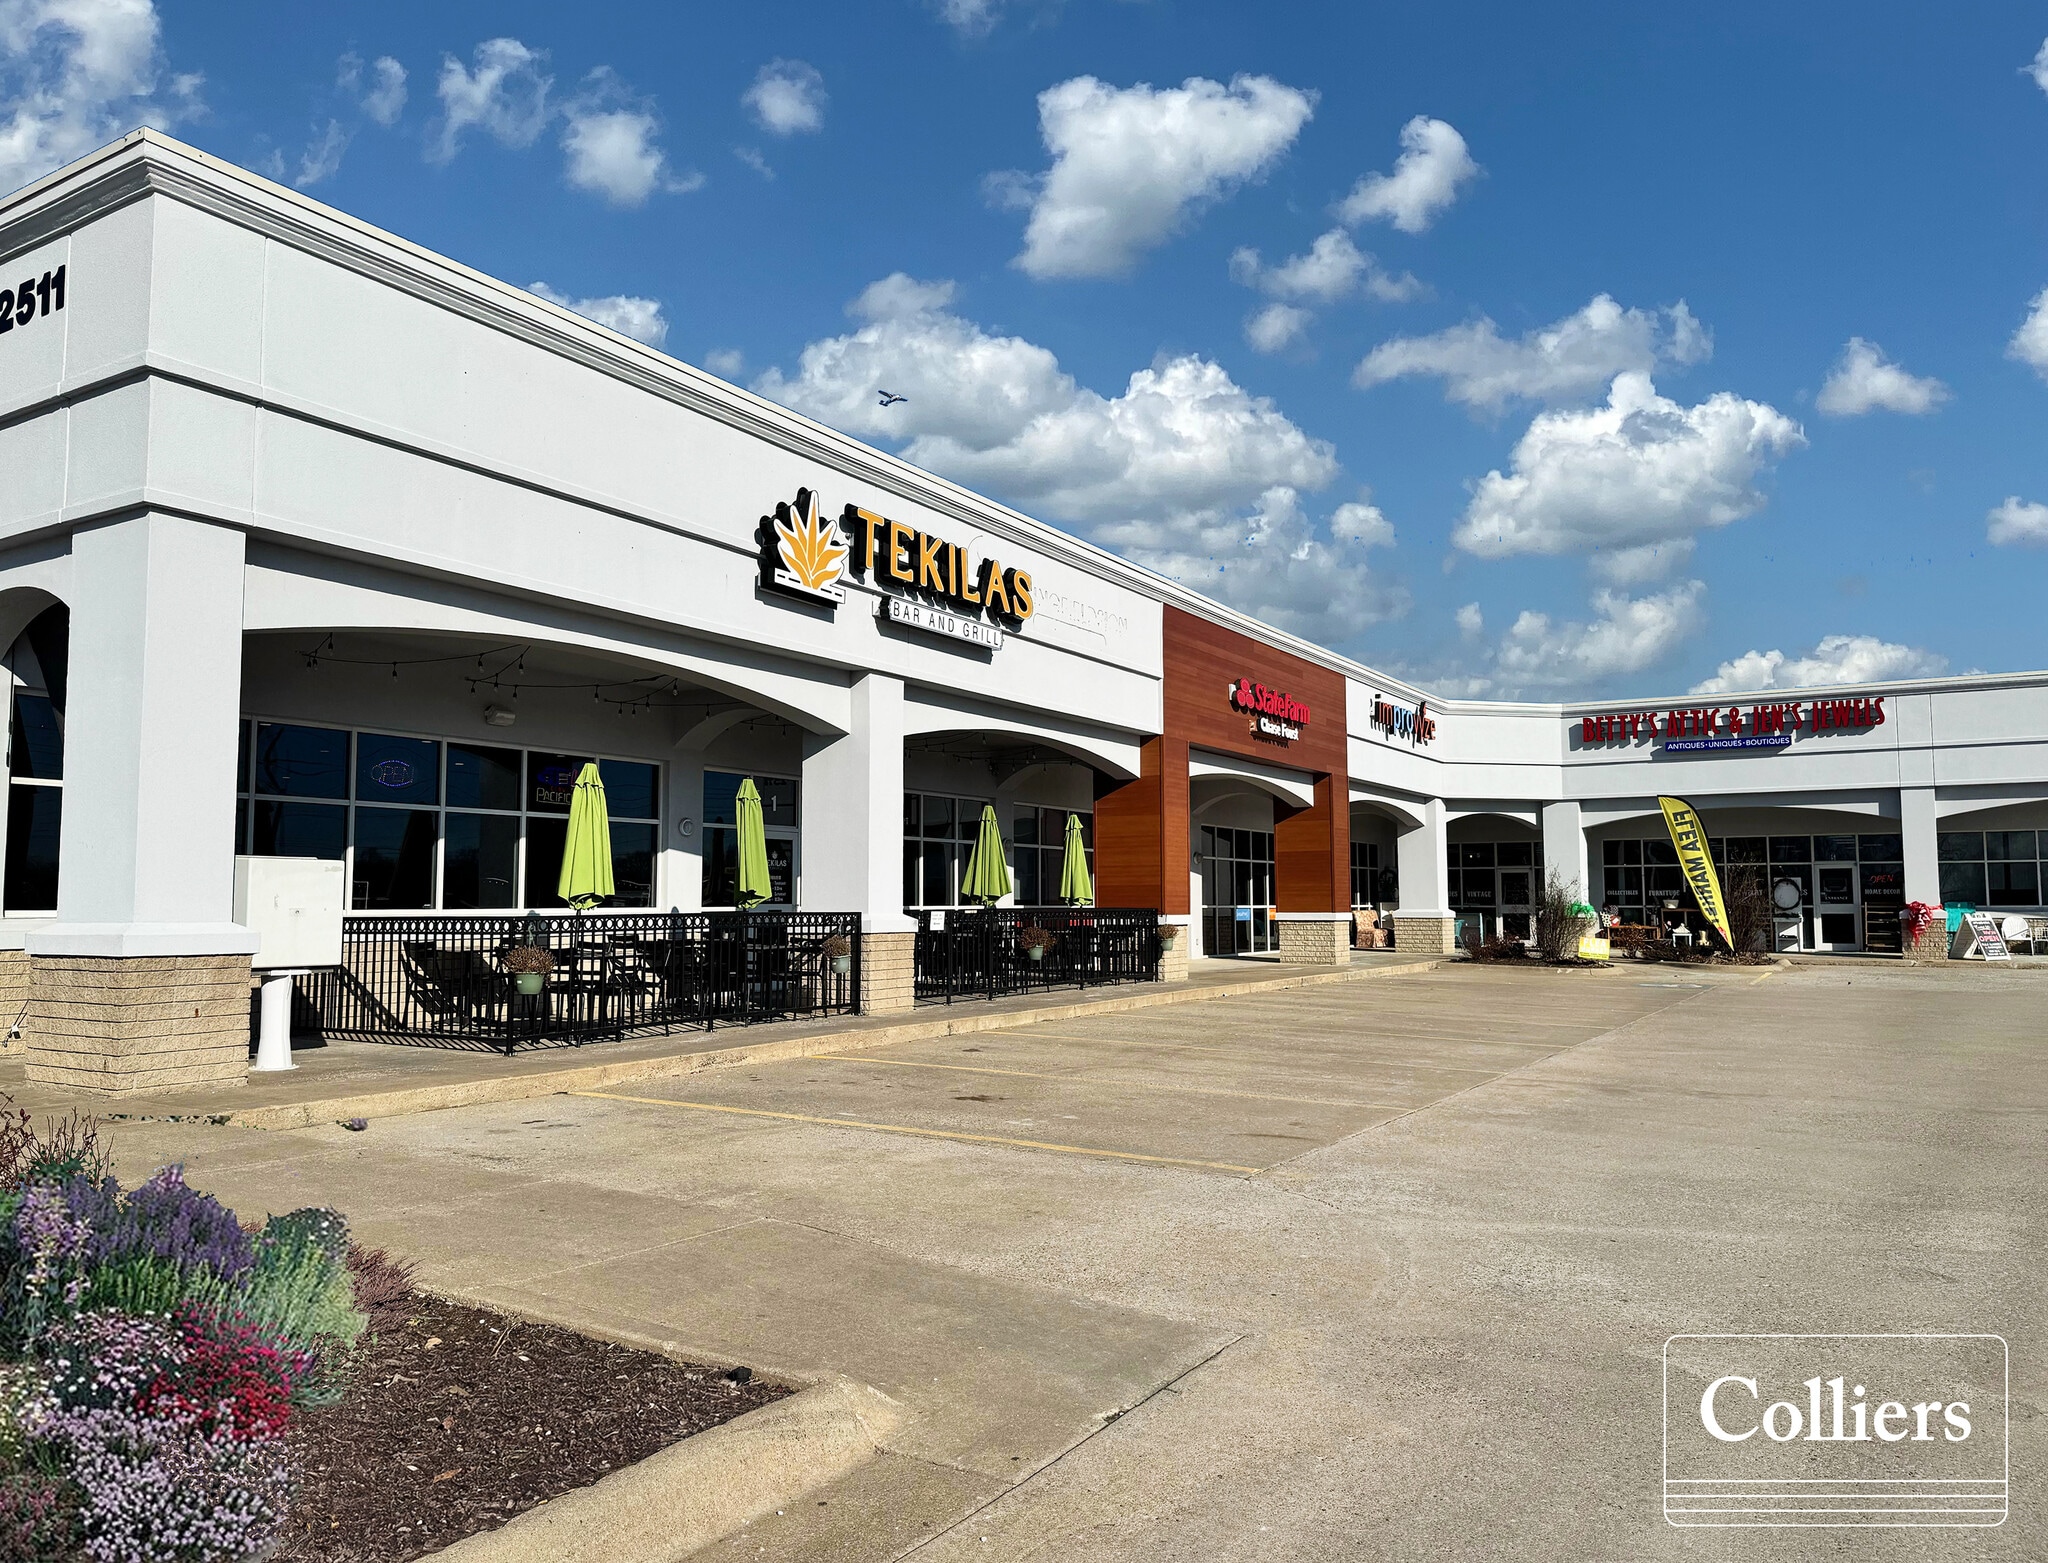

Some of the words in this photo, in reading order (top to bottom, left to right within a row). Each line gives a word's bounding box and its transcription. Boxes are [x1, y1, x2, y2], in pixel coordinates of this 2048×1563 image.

[0, 264, 66, 335] 2511
[857, 507, 1033, 620] TEKILAS
[893, 601, 920, 623] BAR
[928, 612, 955, 633] AND
[962, 622, 999, 646] GRILL
[1582, 712, 1658, 742] BETTY'S
[1667, 708, 1720, 738] ATTIC
[1729, 706, 1742, 734] &
[1752, 702, 1803, 736] JEN'S
[1811, 697, 1886, 732] JEWELS
[371, 764, 414, 783] OPEN
[536, 787, 572, 804] PACIFIC
[771, 795, 777, 812] 1
[1870, 874, 1894, 884] OPEN
[1466, 890, 1492, 898] VINTAGE
